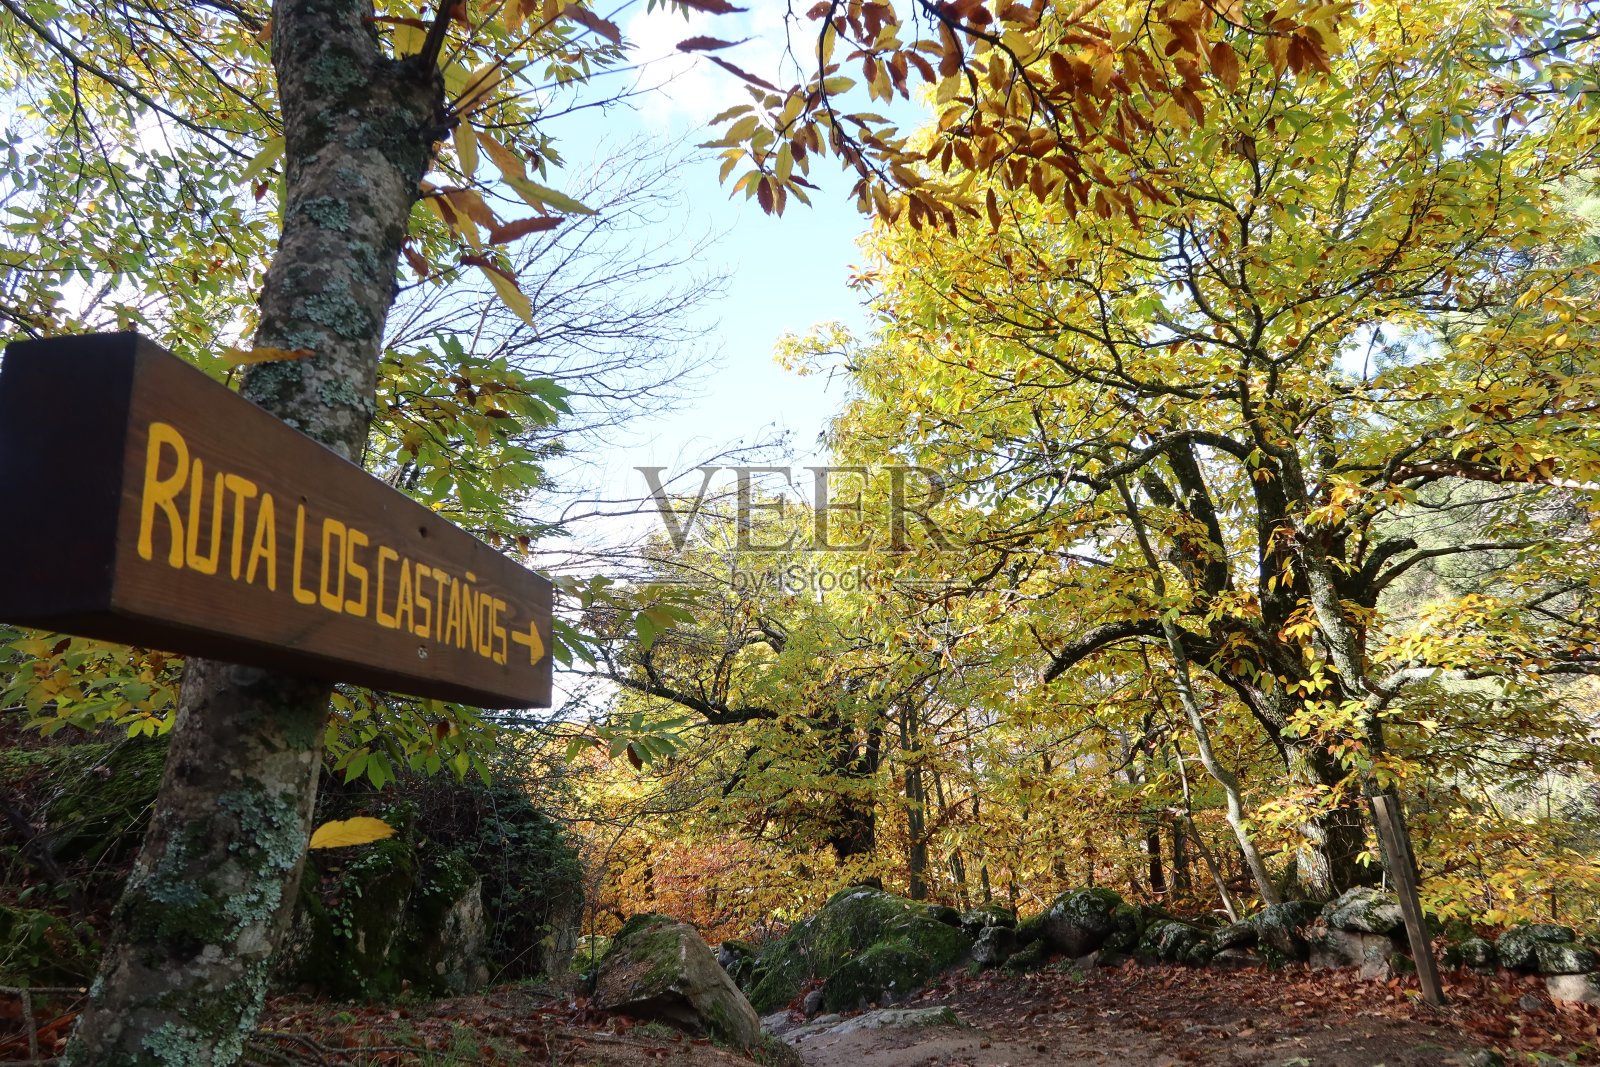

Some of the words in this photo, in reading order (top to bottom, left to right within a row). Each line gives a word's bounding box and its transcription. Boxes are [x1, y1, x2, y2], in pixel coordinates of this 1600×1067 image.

[137, 421, 277, 592] RUTA
[293, 503, 369, 617] LOS
[376, 545, 507, 665] CASTAÑOS
